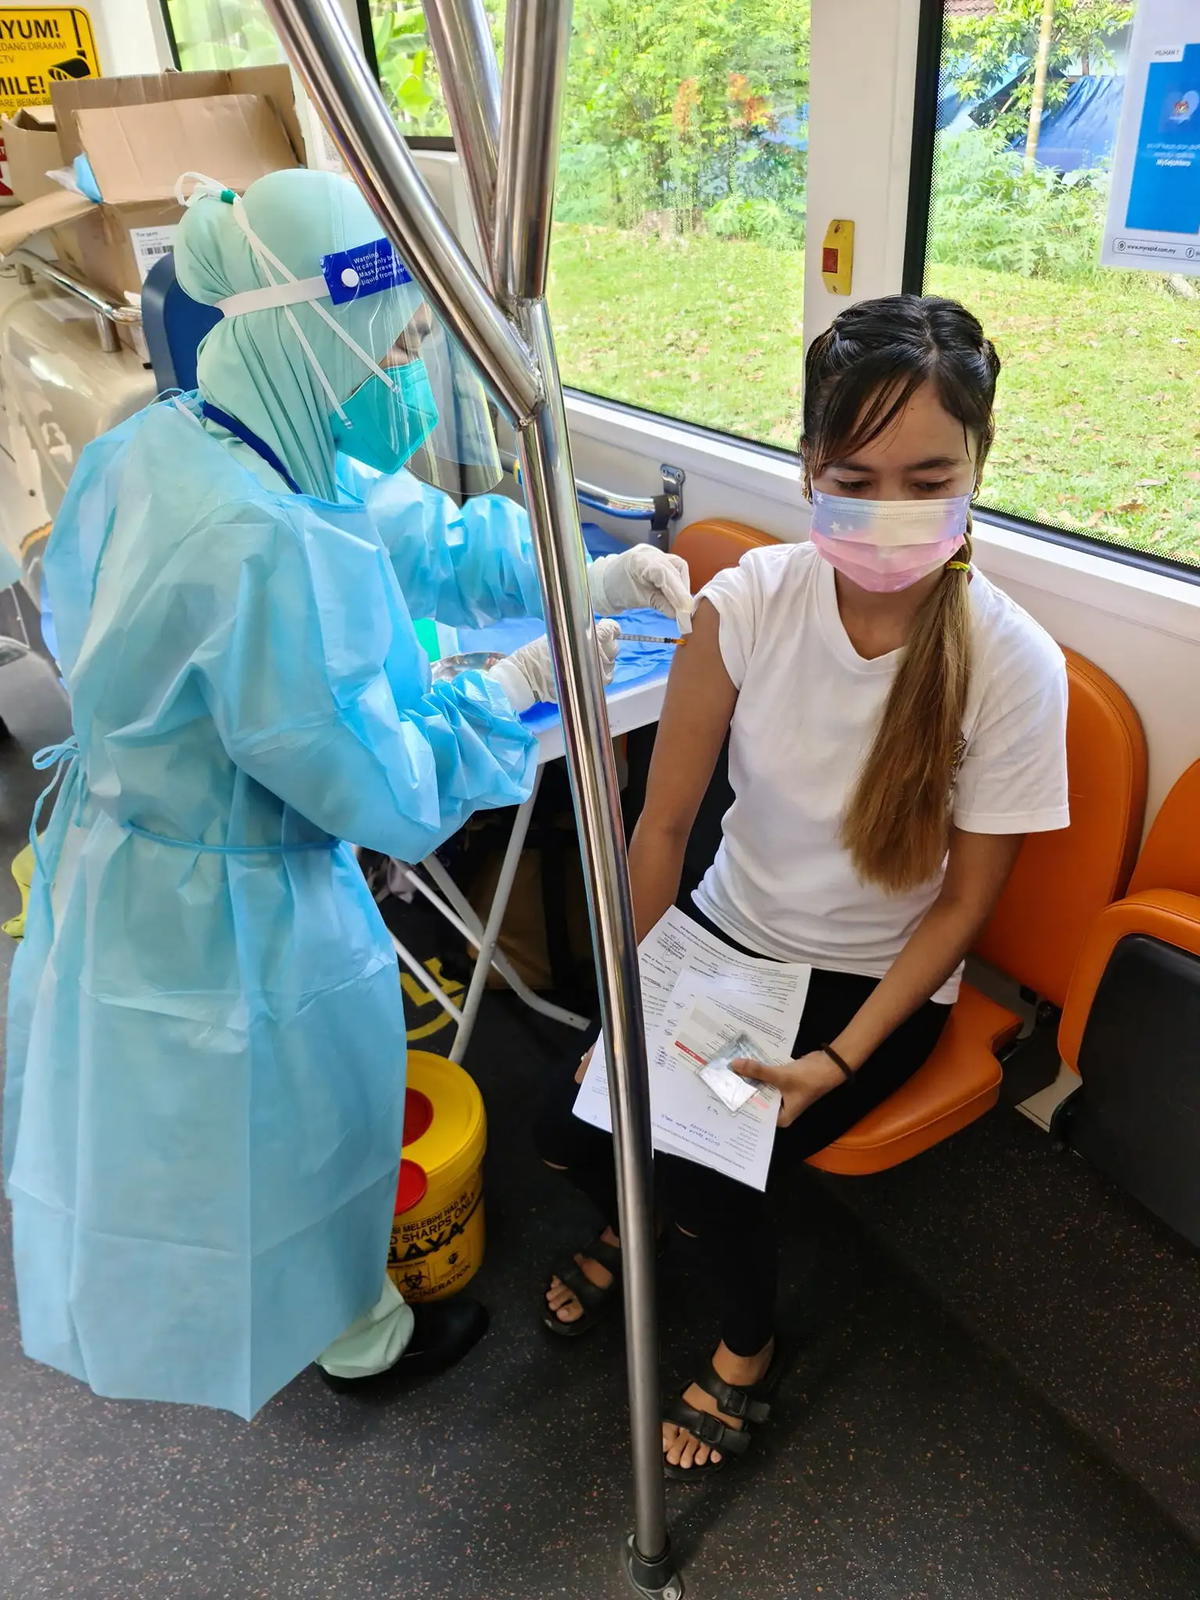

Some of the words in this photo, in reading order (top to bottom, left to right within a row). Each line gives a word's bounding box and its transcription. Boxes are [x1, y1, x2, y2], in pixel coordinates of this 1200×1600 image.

[0, 18, 61, 40] YUM!
[0, 41, 27, 51] DANG
[28, 41, 67, 51] DIRAKAM
[401, 1215, 451, 1245] SHARPS
